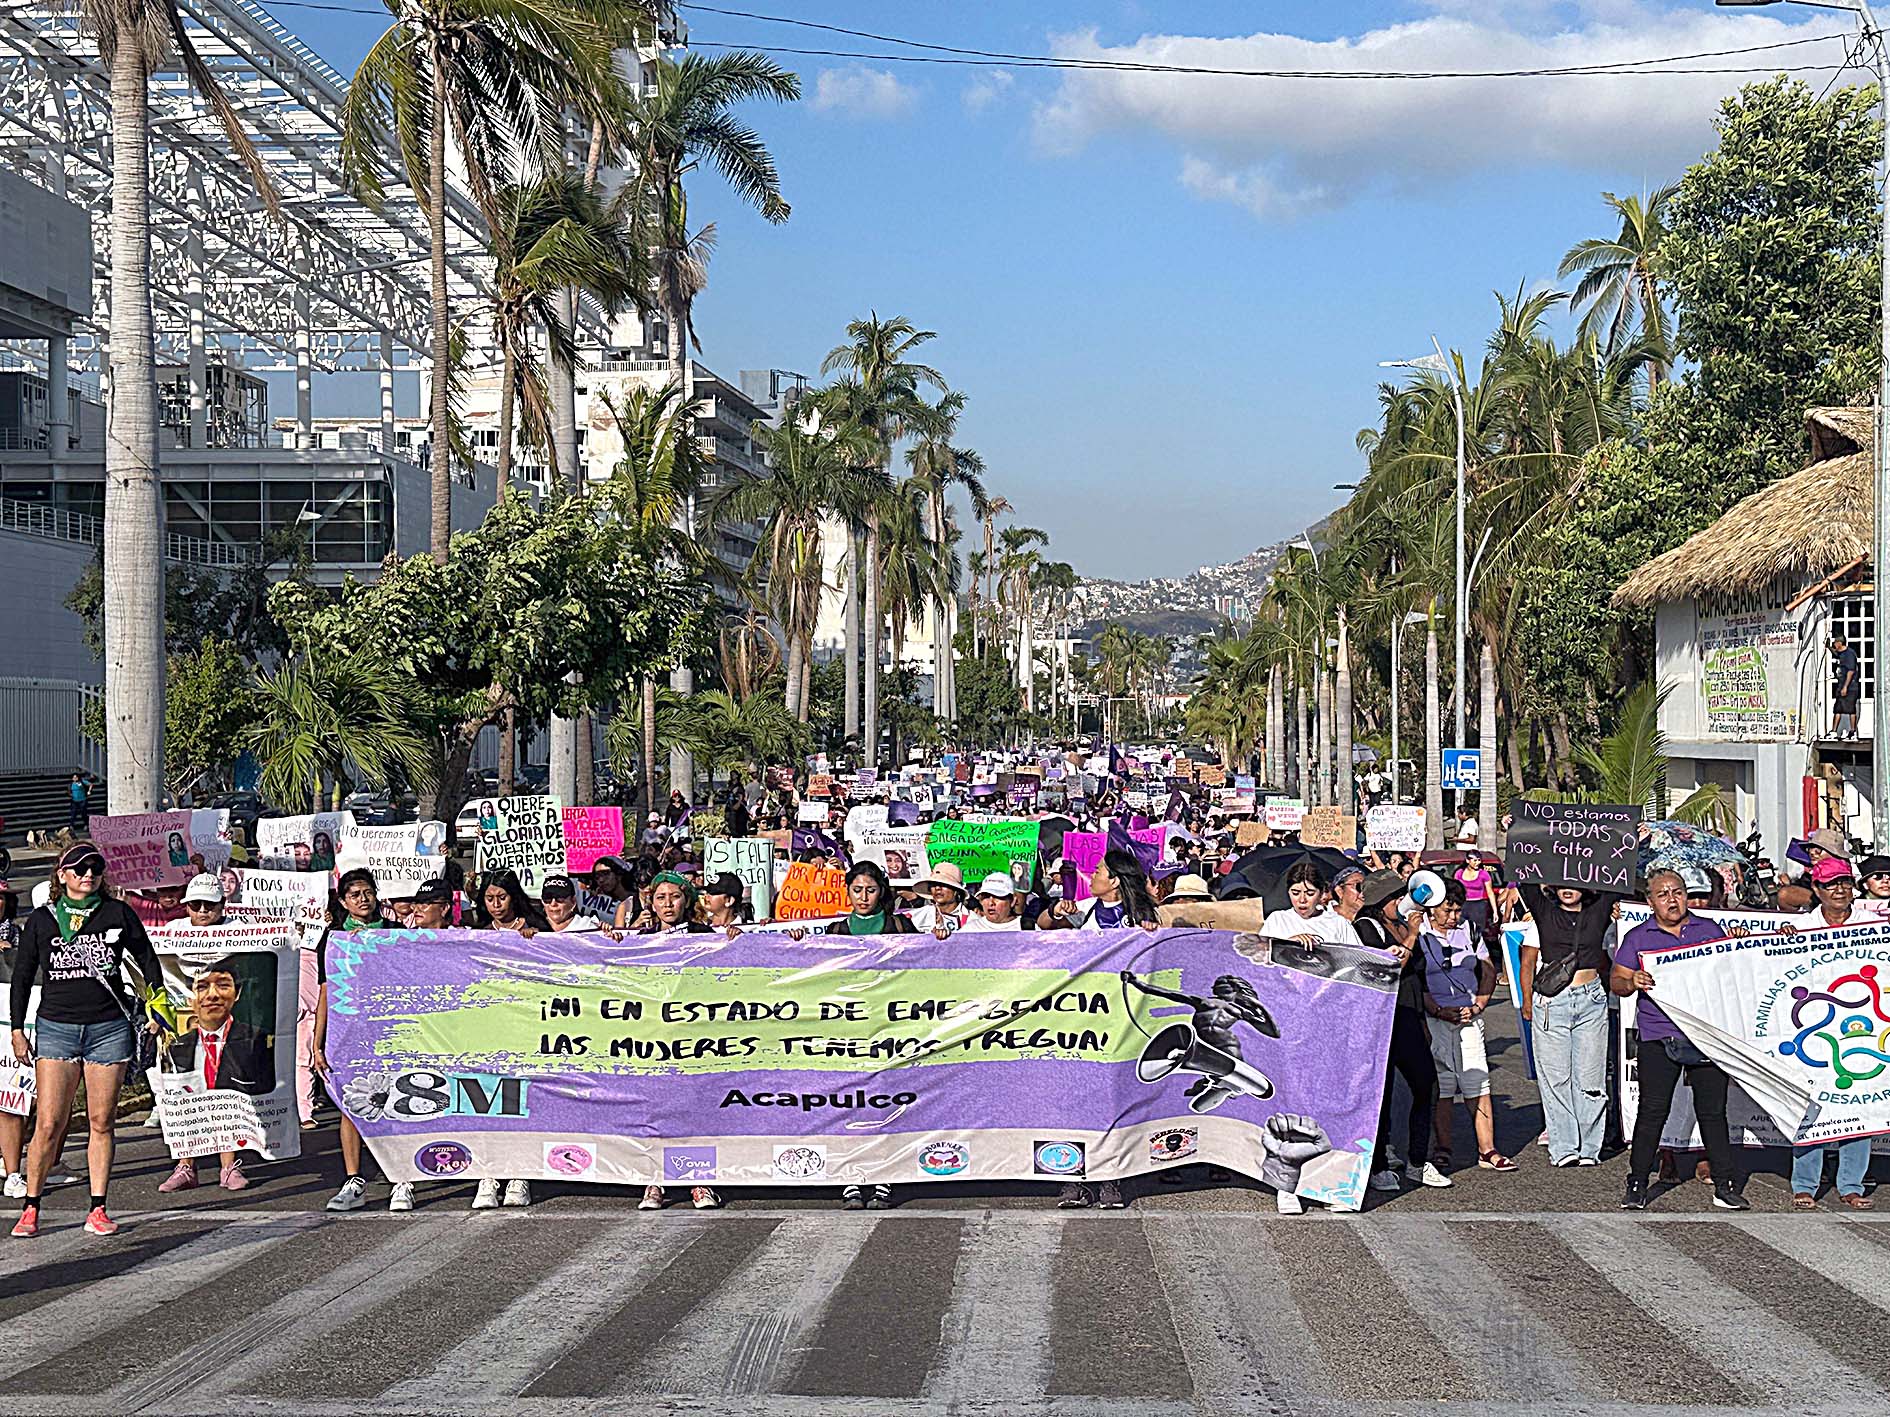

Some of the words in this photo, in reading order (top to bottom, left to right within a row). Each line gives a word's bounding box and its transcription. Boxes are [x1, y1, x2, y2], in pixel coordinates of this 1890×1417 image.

[508, 811, 541, 827] MOS
[546, 807, 557, 823] A
[561, 807, 589, 820] LERTA
[1524, 803, 1555, 818] NO
[1564, 809, 1631, 822] estamos
[482, 827, 543, 845] GLORIA
[545, 823, 563, 840] DE
[932, 820, 988, 835] EVELYN
[1547, 819, 1611, 843] TODAS
[925, 832, 985, 845] SALGADO
[1070, 836, 1100, 850] LAS
[102, 843, 143, 860] LORIA
[482, 841, 533, 858] VUELTA
[537, 840, 546, 851] Y
[549, 841, 565, 851] LA
[735, 840, 774, 864] FALT
[1512, 841, 1542, 855] nos
[1553, 840, 1594, 858] falta
[368, 857, 382, 867] De
[485, 851, 566, 871] QUEREMOS
[110, 869, 156, 884] ACINTO
[372, 868, 393, 881] ana
[396, 868, 404, 881] Y
[1515, 863, 1543, 881] 8M
[1563, 857, 1628, 887] LUISA
[245, 877, 283, 892] TODAS
[782, 885, 810, 903] CON
[814, 889, 842, 907] VIDA
[301, 906, 322, 920] SUS
[174, 929, 209, 938] HASTA
[212, 926, 288, 938] ENCONTRARTE
[163, 938, 222, 949] Guadalupe
[225, 935, 268, 947] Romero
[271, 935, 286, 947] Gil
[1656, 946, 1713, 966] FAMILIAS
[1716, 942, 1732, 952] DE
[1735, 934, 1807, 950] ACAPULCO
[1810, 932, 1828, 943] EN
[1832, 926, 1877, 939] BUSCA
[1881, 925, 1890, 935] D
[1764, 945, 1808, 957] UNIDOS
[1810, 942, 1834, 952] POR
[1837, 941, 1848, 949] EL
[50, 946, 116, 963] MACISTA
[53, 957, 114, 969] RESISTNCIA
[540, 997, 581, 1021] ¡NI
[600, 998, 643, 1021] EN
[661, 1000, 799, 1023] ESTADO
[819, 1000, 869, 1022] DE
[887, 992, 1110, 1022] EMEGENCIA
[1755, 979, 1788, 1038] FAMILIAS
[1784, 963, 1809, 982] DE
[540, 1033, 592, 1056] LAS
[609, 1035, 761, 1062] MUJERES
[395, 1072, 528, 1117] 8M
[720, 1089, 918, 1112] Acapulco
[167, 1130, 184, 1139] amá
